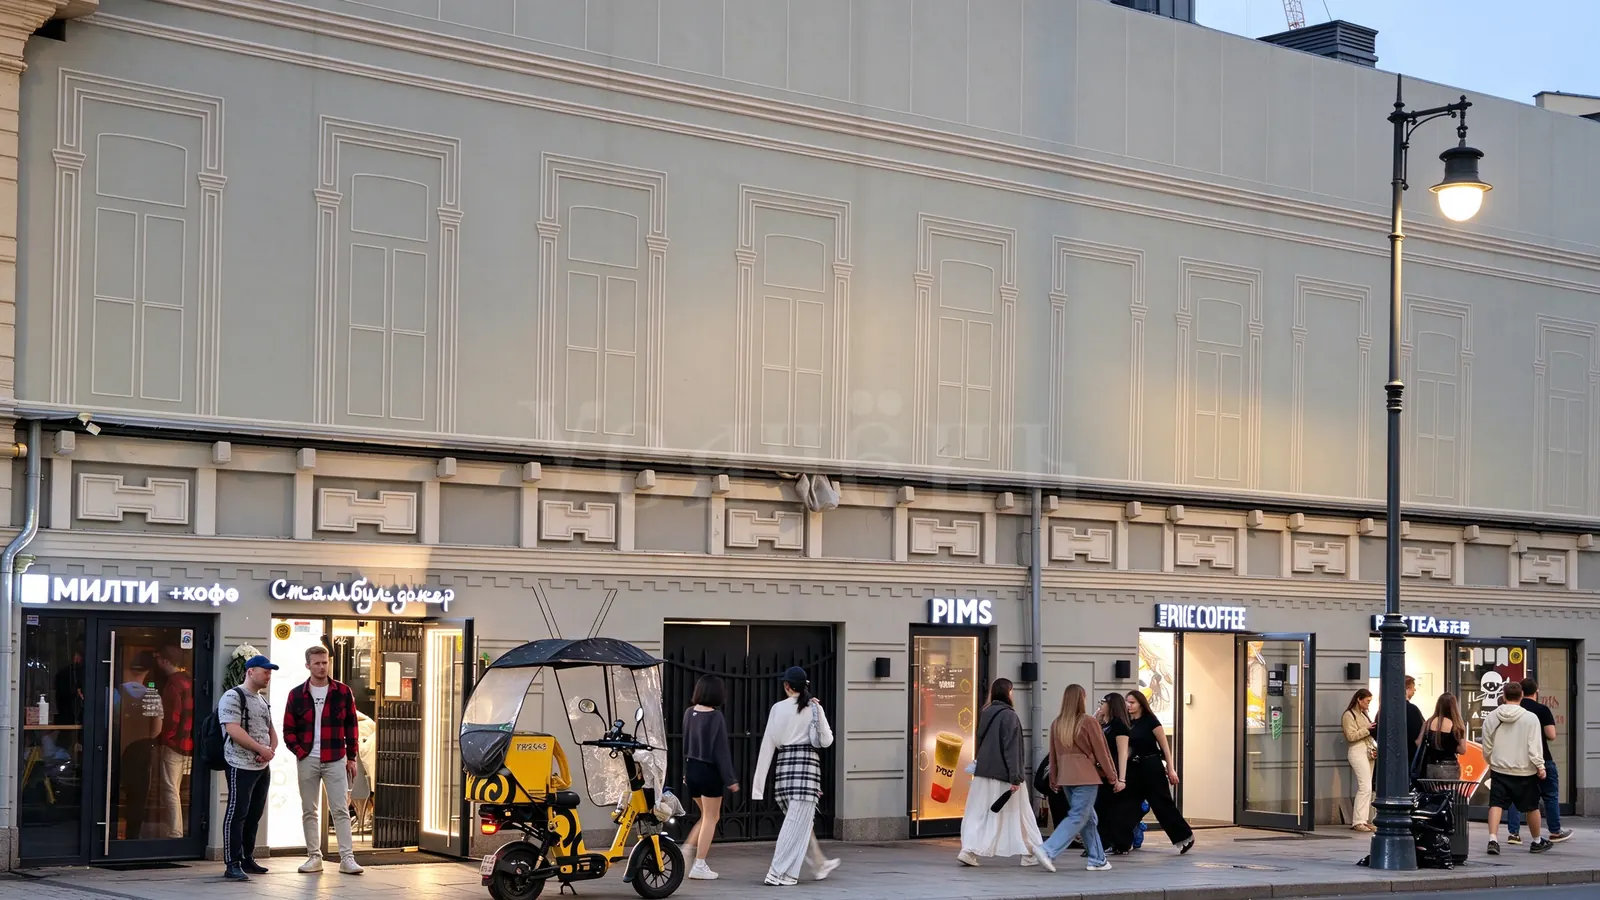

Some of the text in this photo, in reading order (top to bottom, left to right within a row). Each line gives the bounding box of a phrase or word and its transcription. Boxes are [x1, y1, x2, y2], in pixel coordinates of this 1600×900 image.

[53, 577, 160, 604] МИЛТИ
[932, 598, 992, 625] PIMS
[1196, 605, 1247, 630] COFFEE
